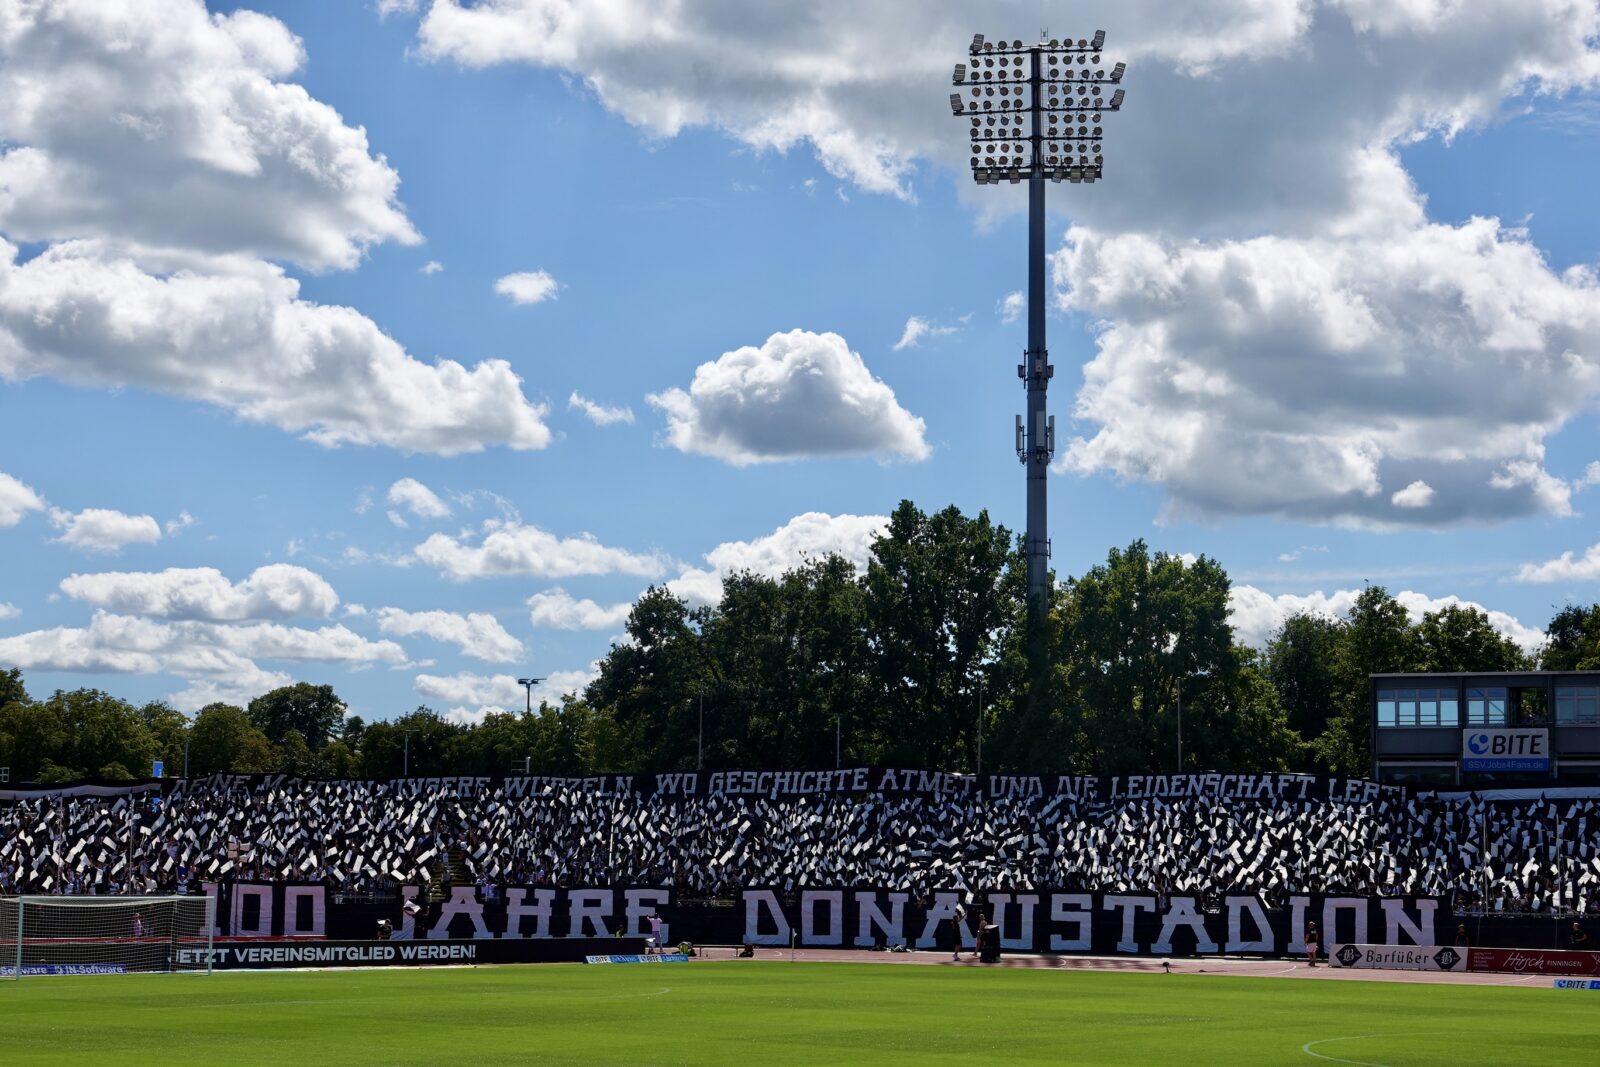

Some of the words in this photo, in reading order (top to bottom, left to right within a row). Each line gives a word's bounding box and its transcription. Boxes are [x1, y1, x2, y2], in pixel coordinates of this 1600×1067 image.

[1492, 735, 1543, 755] BITE
[656, 773, 698, 794] WO
[709, 768, 869, 794] GESCHICHTE
[878, 769, 977, 796] ATMET
[990, 775, 1043, 798] UND
[1110, 774, 1316, 799] LEIDENSCHAFT
[201, 883, 325, 936] 100
[234, 946, 395, 962] VEREINSMITGLIED
[399, 945, 476, 959] WERDEN!
[1366, 949, 1429, 963] Barfüßer
[1503, 952, 1544, 971] Hirsch
[1566, 980, 1586, 989] BITE
